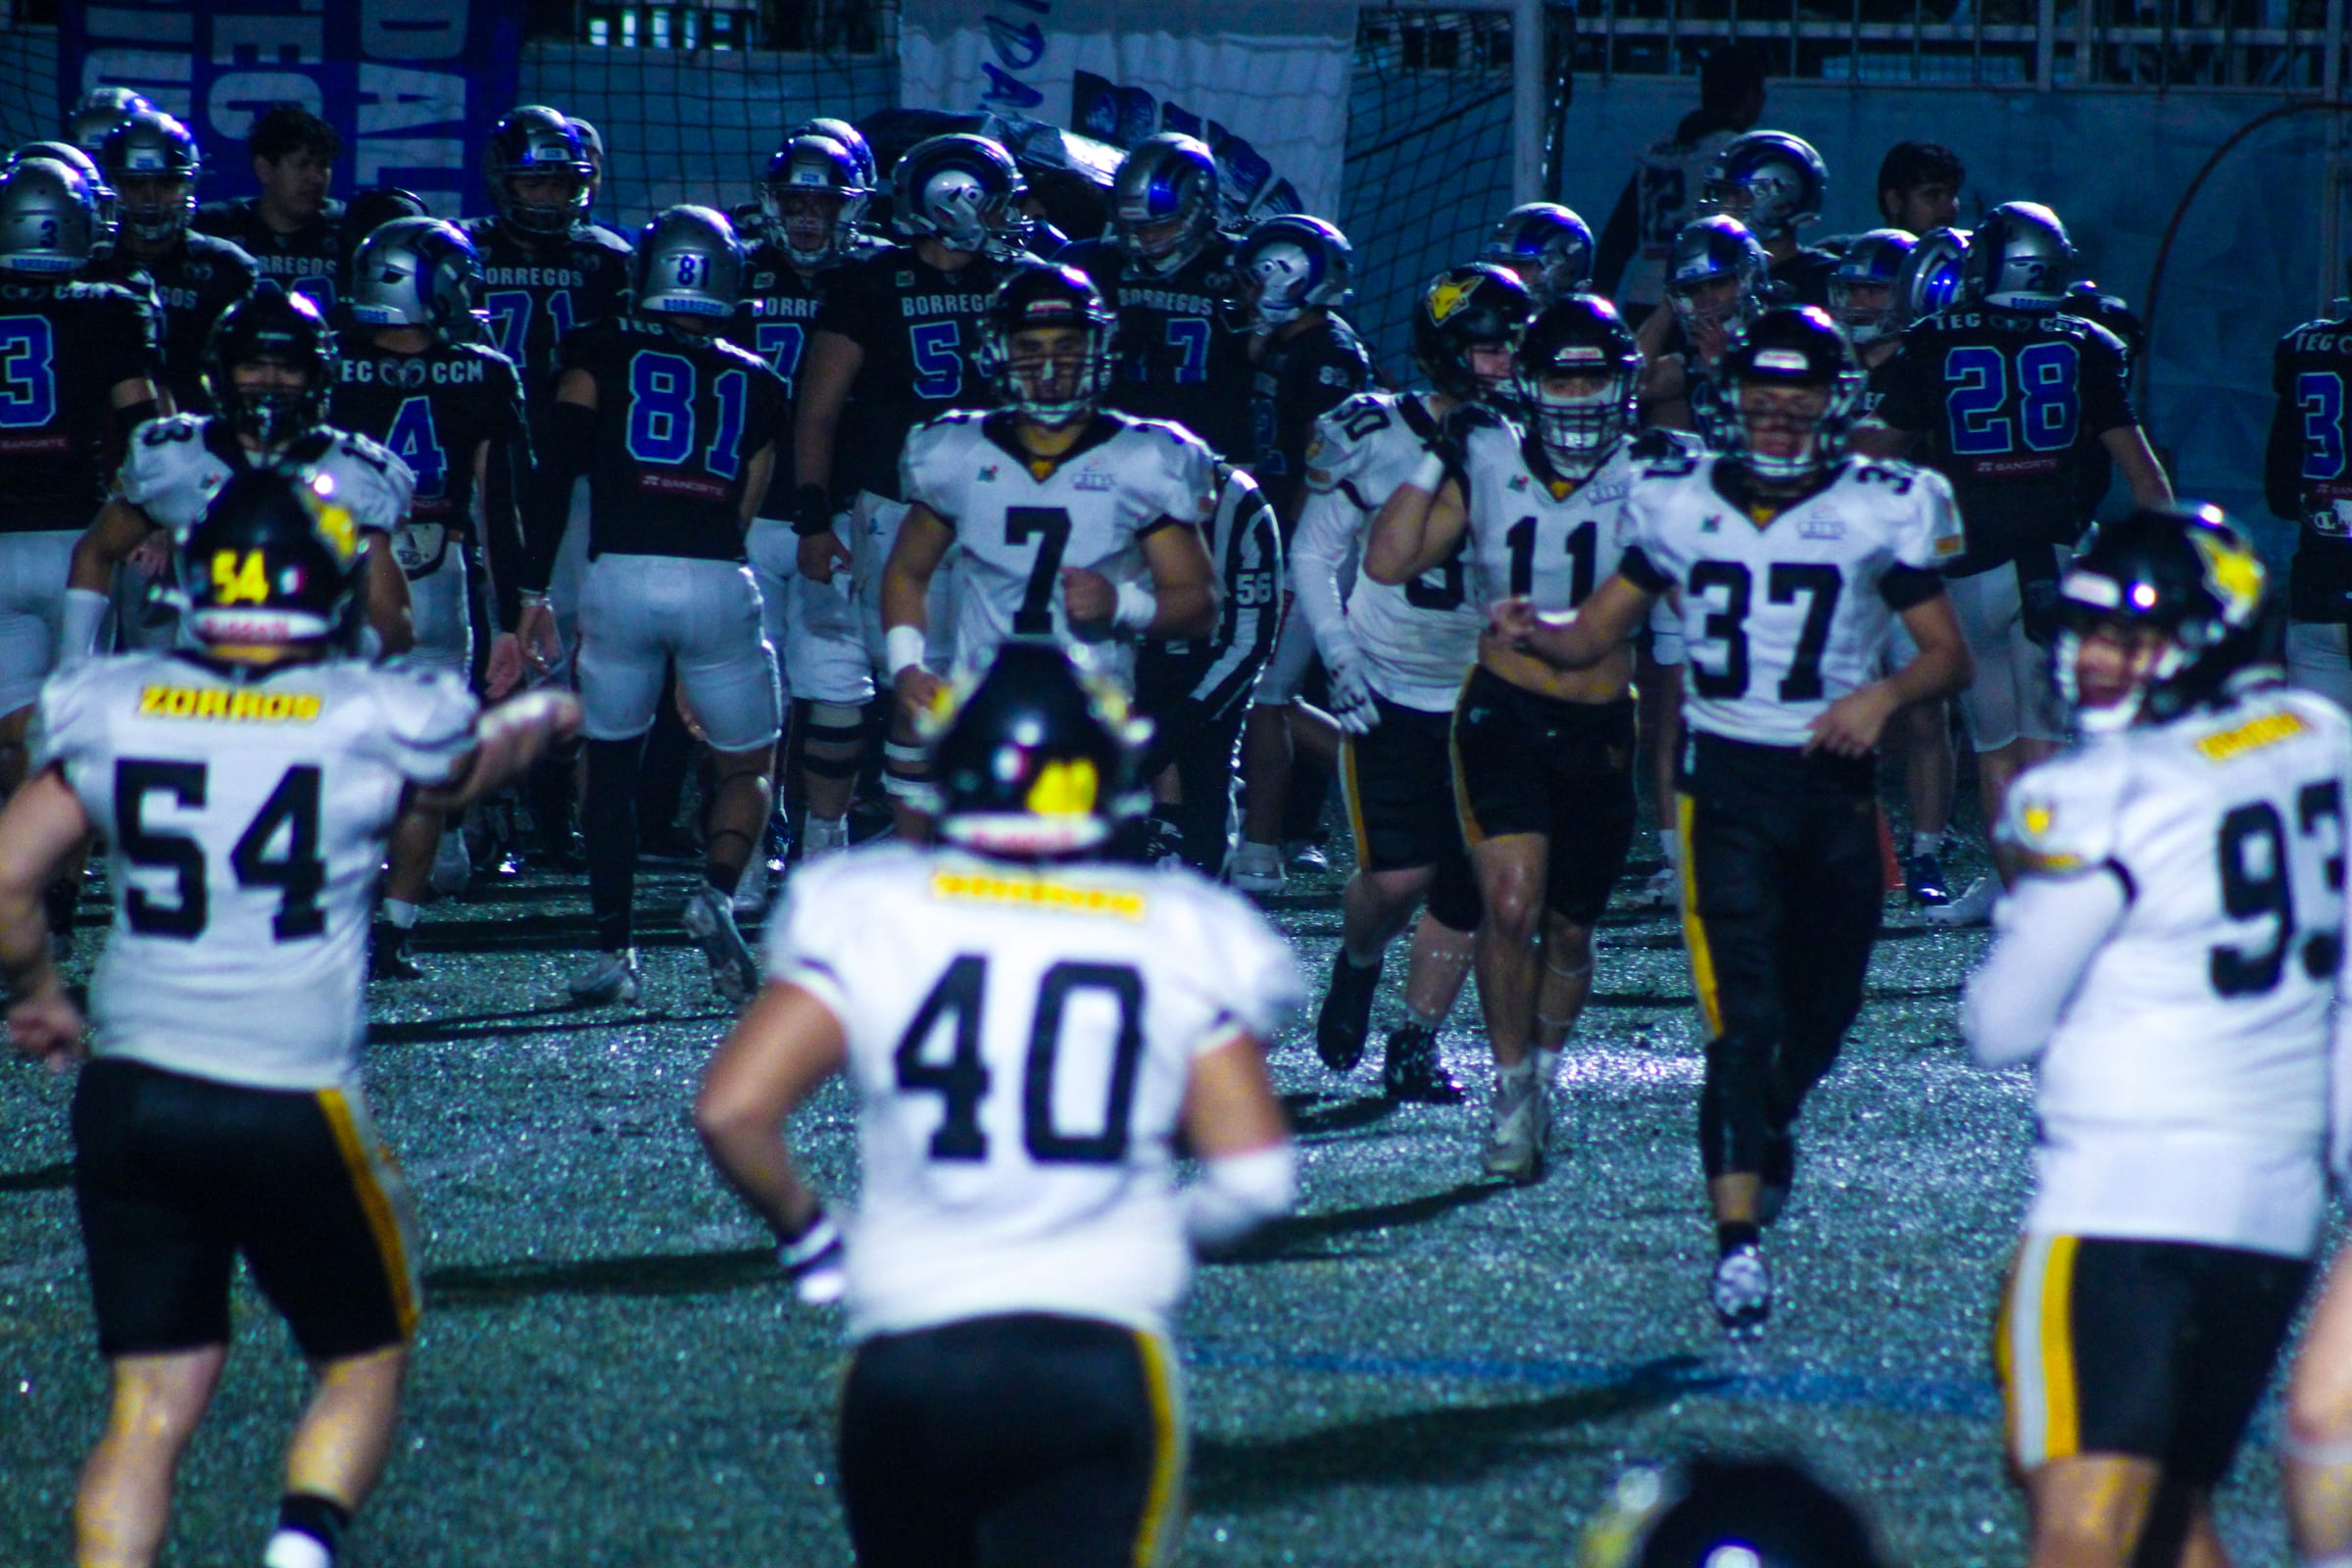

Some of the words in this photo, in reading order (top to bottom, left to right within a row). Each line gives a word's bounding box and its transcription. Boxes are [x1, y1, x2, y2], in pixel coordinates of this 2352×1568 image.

[40, 220, 58, 247] 3
[257, 255, 337, 274] RREGOS
[486, 267, 583, 287] ORREGOS
[677, 255, 710, 287] 81
[0, 314, 57, 429] 3
[342, 359, 374, 382] EC
[484, 289, 575, 368] 71
[908, 319, 994, 399] 5
[383, 395, 449, 498] 4
[624, 348, 748, 480] 81
[1943, 340, 2082, 456] 28
[2295, 370, 2347, 480] 3
[211, 548, 270, 606] 54
[1004, 506, 1072, 634] 7
[1506, 515, 1597, 610] 11
[1687, 559, 1843, 703] 37
[116, 759, 325, 940] 54
[2210, 779, 2344, 998] 93
[894, 953, 1147, 1164] 40
